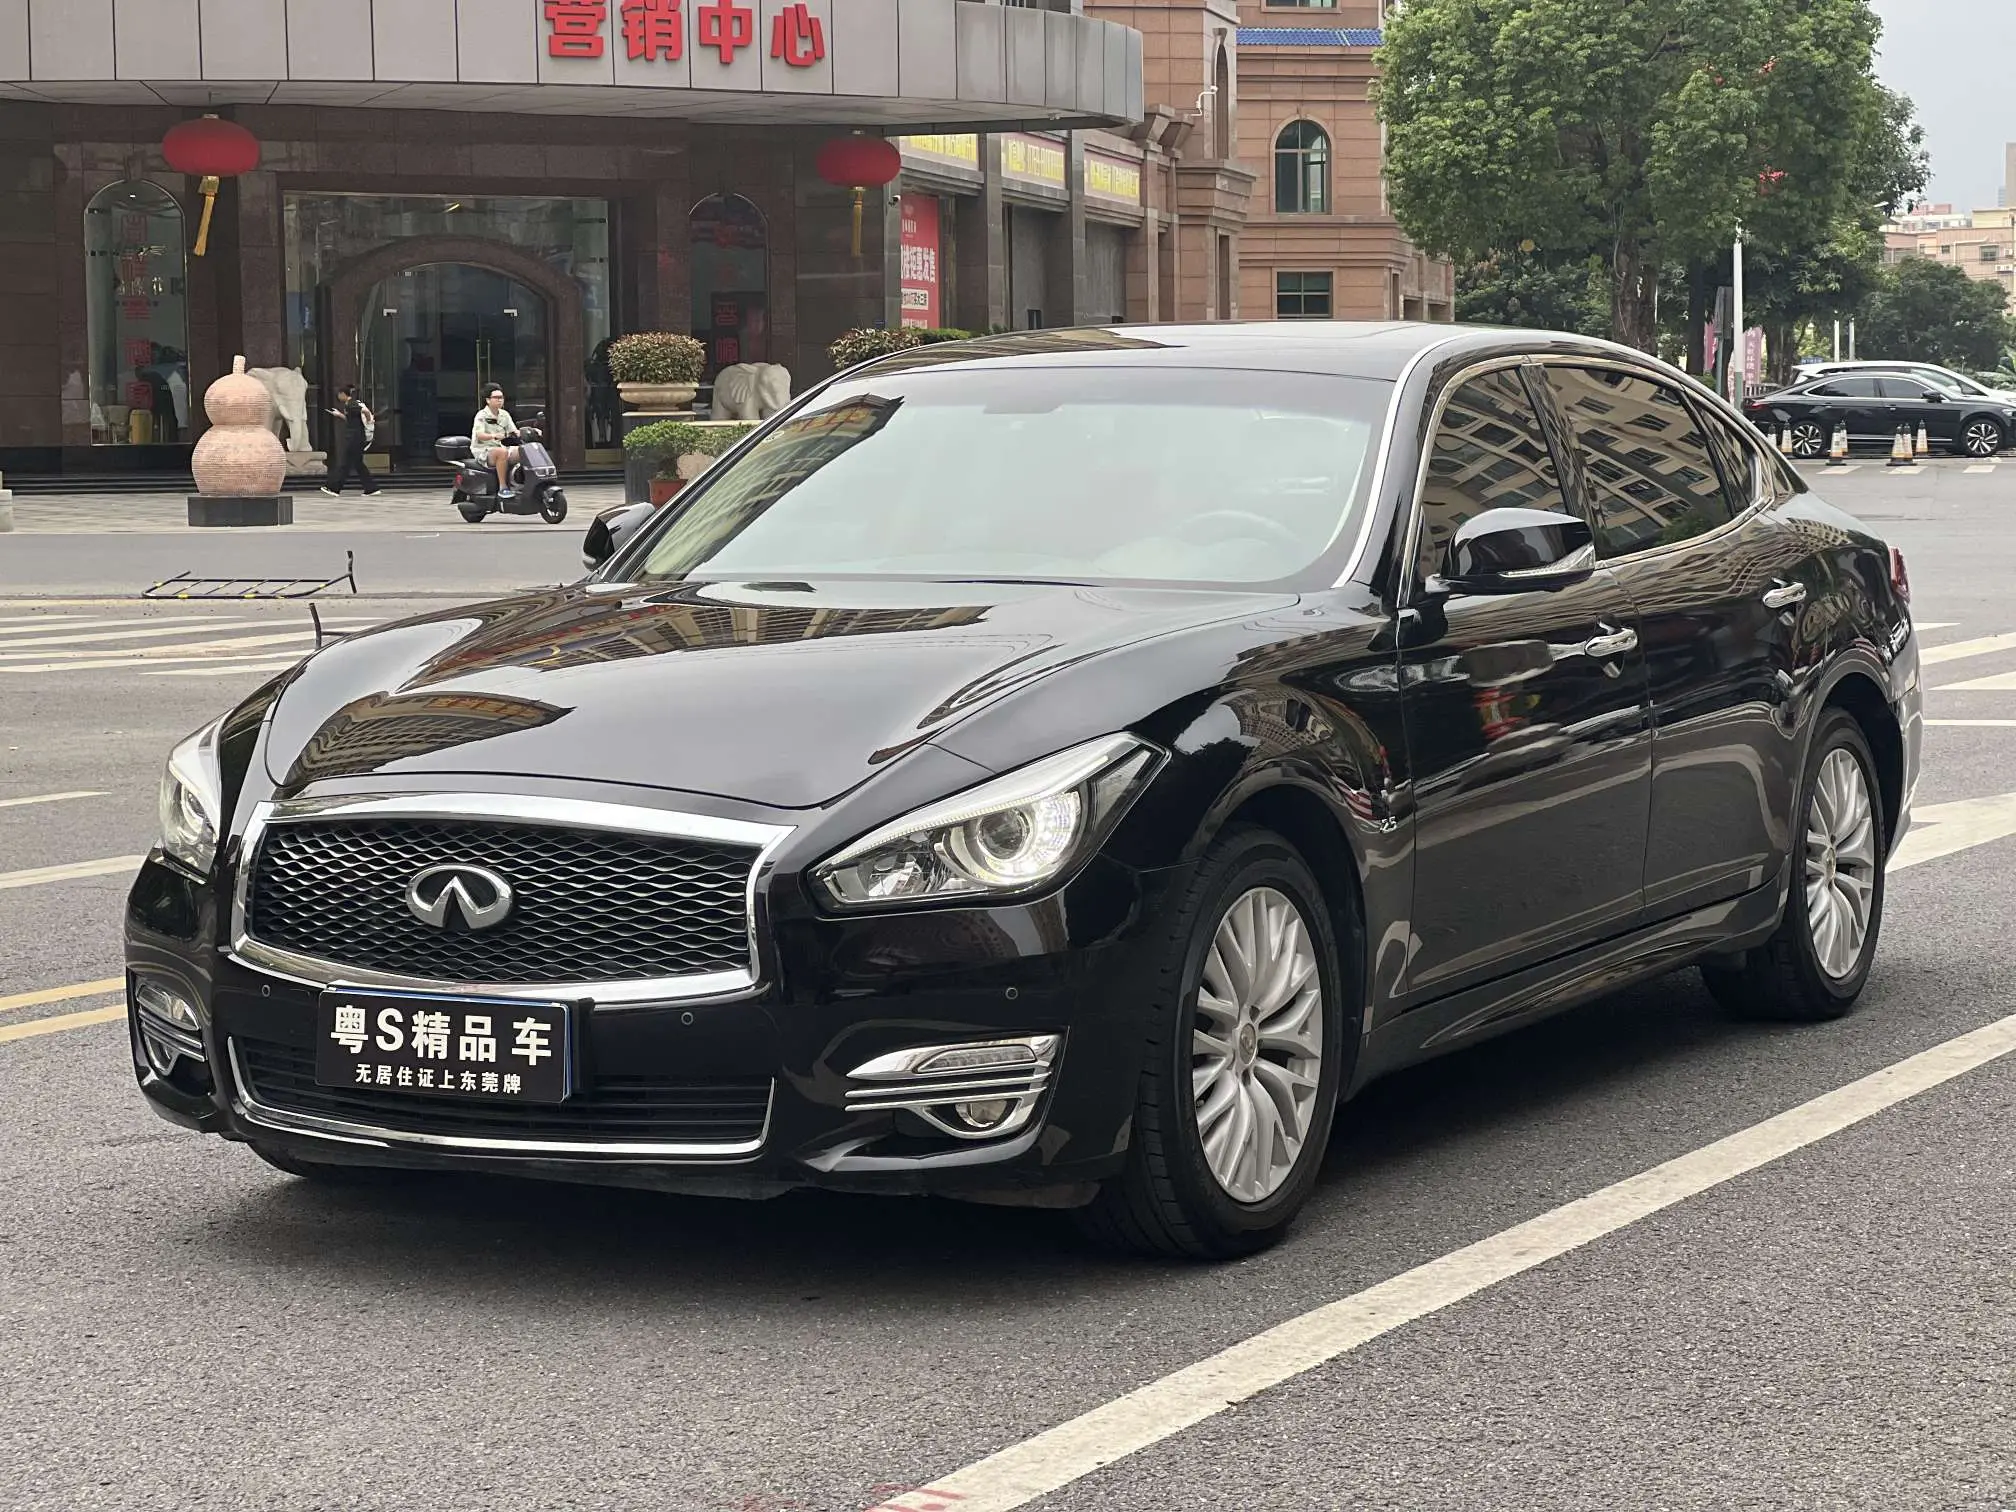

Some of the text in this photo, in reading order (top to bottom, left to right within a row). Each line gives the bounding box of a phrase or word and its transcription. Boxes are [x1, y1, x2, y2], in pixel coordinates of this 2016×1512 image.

[544, 0, 826, 66] 营销中心
[331, 1005, 552, 1066] 粤S精品车
[355, 1063, 522, 1095] 无居住证上东莞牌
